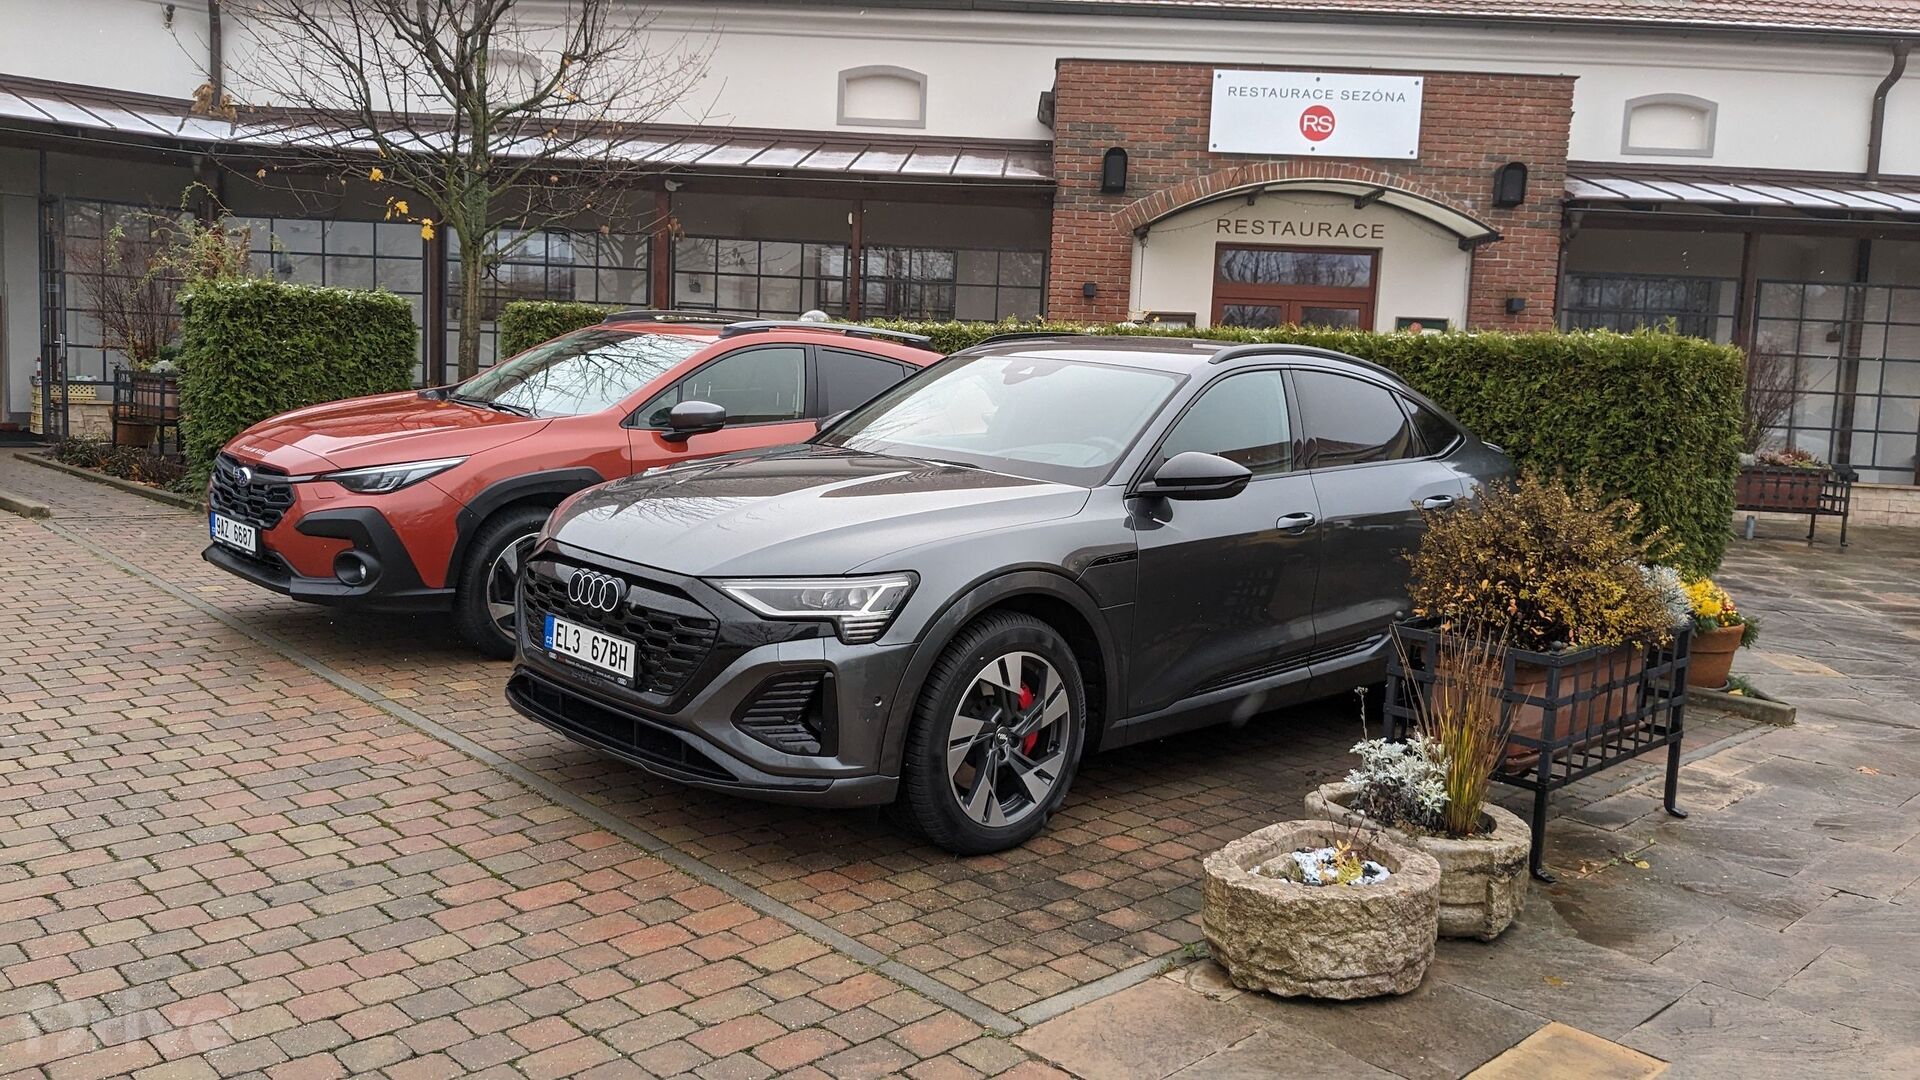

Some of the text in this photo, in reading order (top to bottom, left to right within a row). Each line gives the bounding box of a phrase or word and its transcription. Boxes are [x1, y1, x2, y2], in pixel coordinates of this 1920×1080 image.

[1228, 86, 1406, 102] RESTAURACE SEZÓNA
[1303, 114, 1333, 133] RS
[1216, 218, 1385, 239] RESTAURACE
[216, 517, 229, 538] 9AZ
[233, 524, 252, 547] 6687
[556, 622, 628, 671] EL3 67BH
